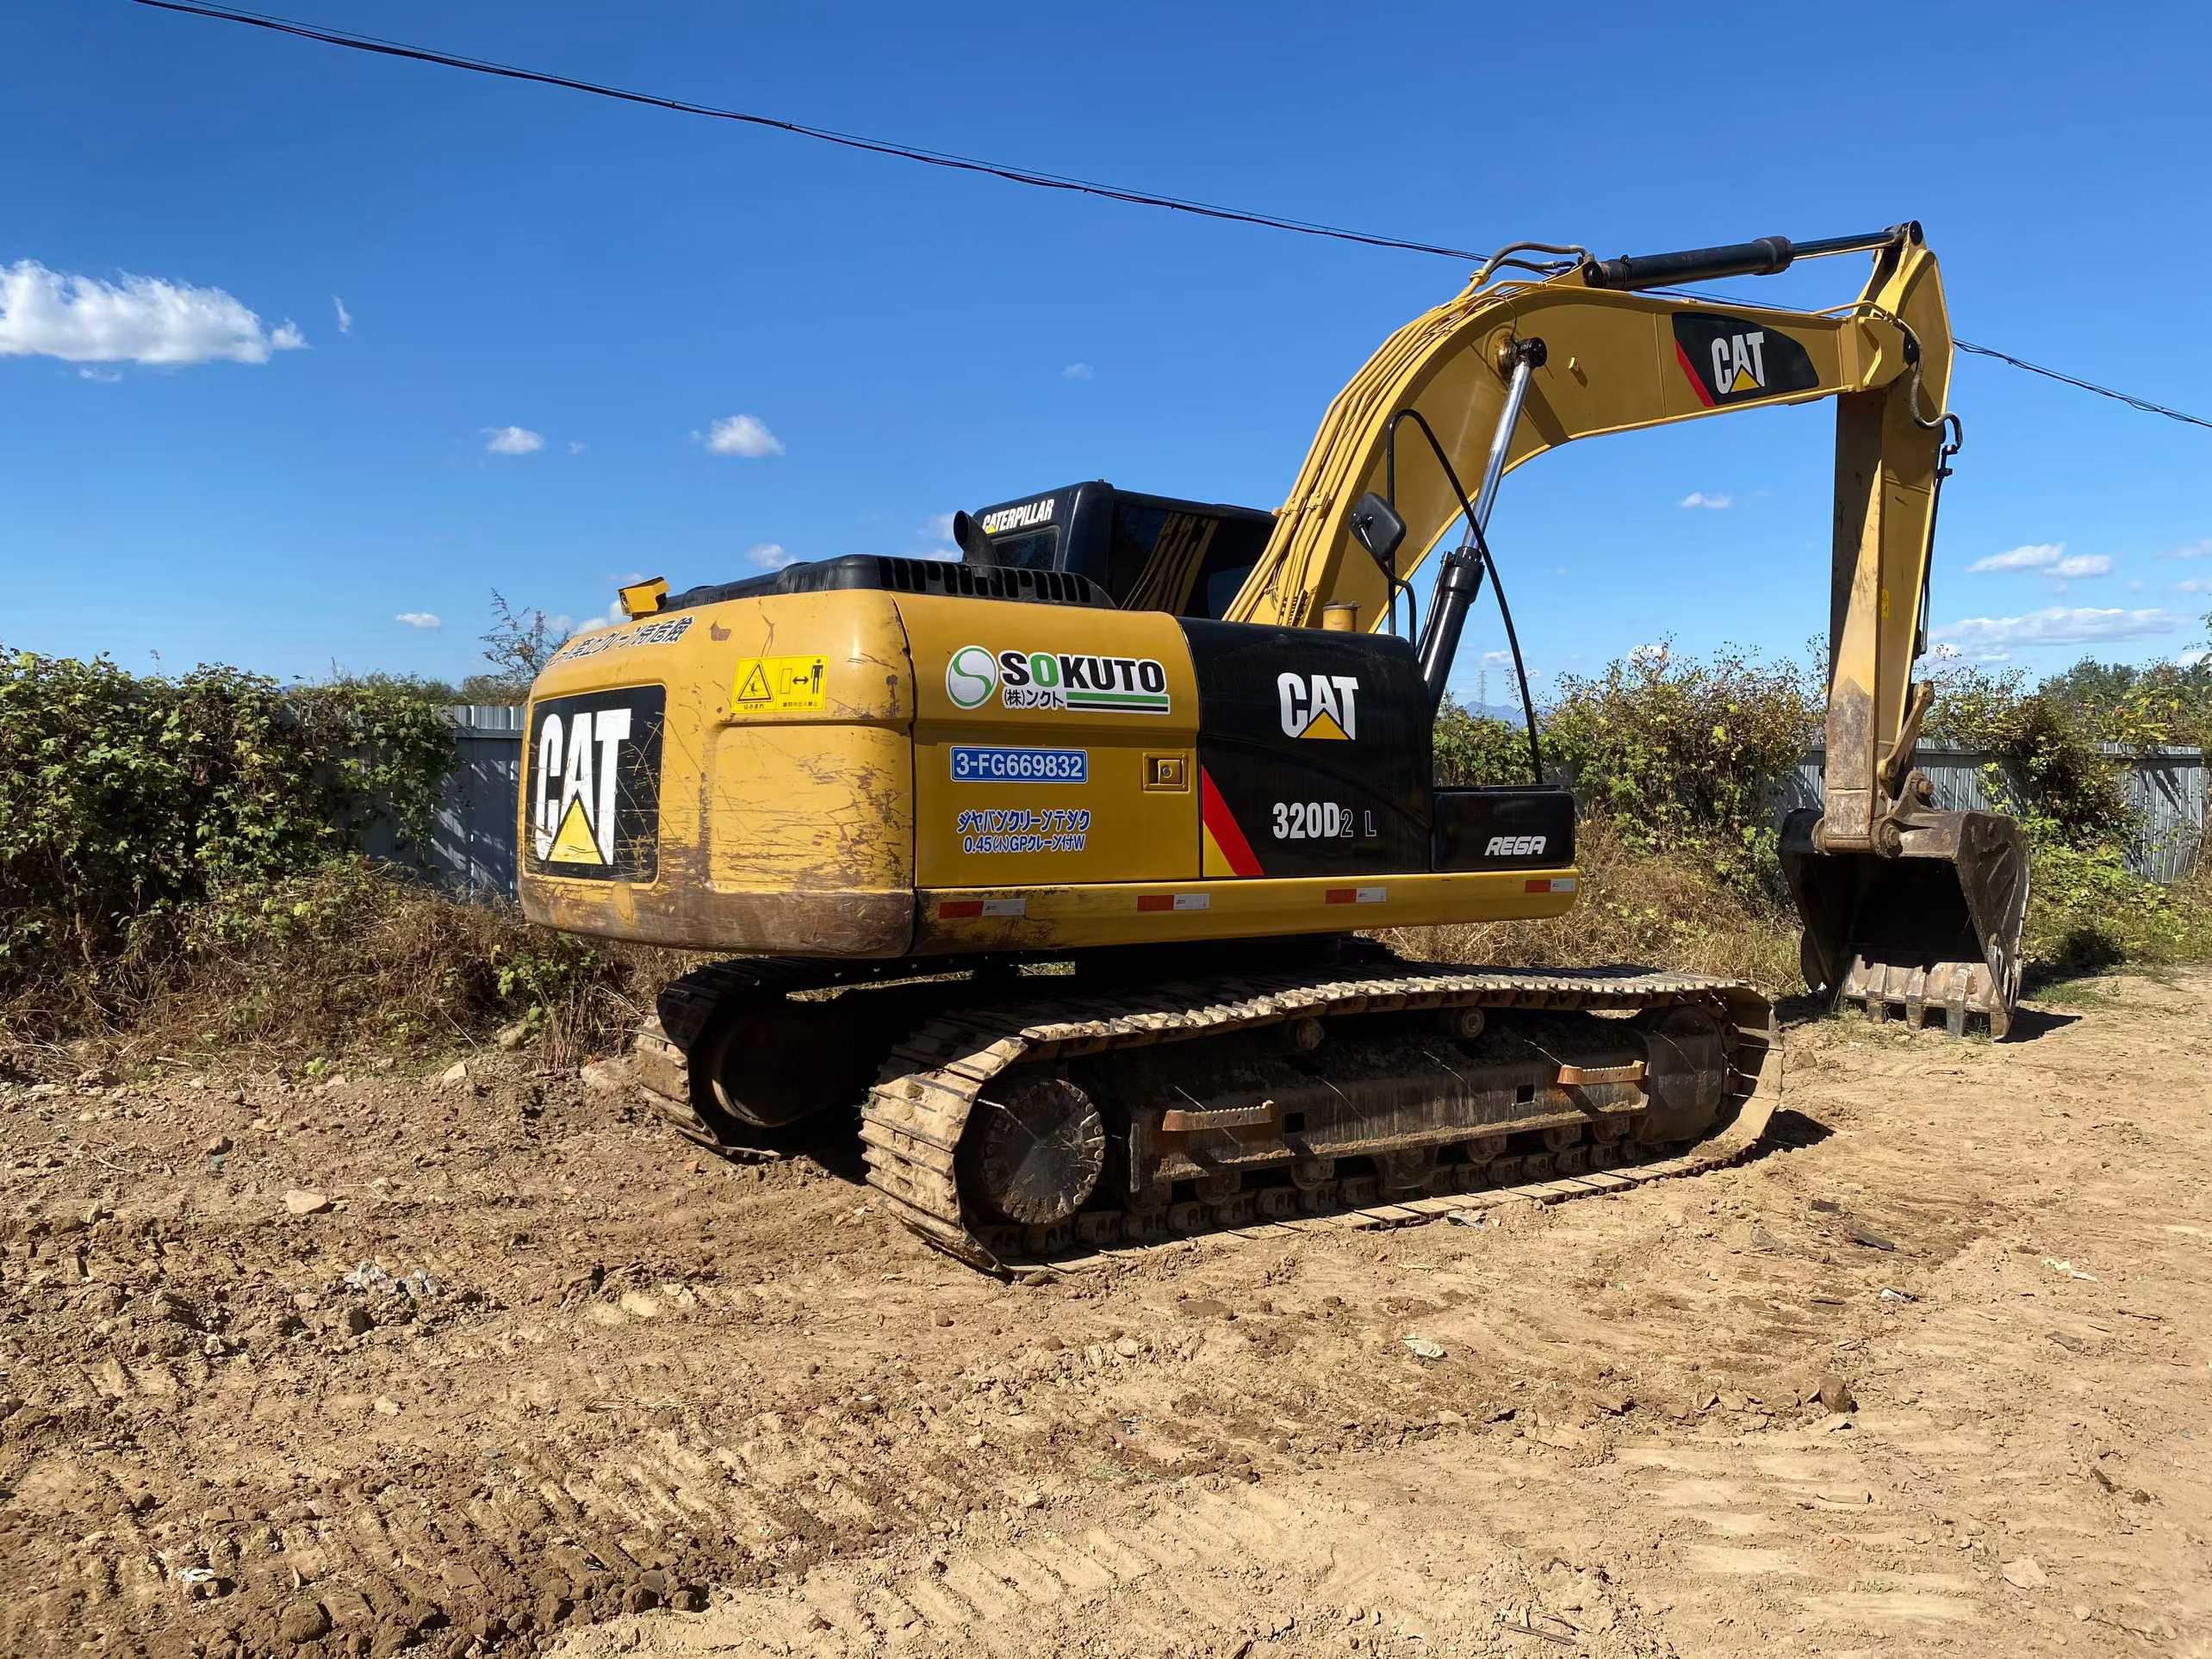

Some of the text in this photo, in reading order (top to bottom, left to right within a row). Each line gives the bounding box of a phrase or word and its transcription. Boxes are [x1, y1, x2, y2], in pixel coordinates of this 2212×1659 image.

[1711, 331, 1766, 394] CAT
[982, 498, 1055, 534] CATERPILLAR
[999, 652, 1166, 693] SOKUTO
[1277, 672, 1359, 741] CAT
[955, 752, 1084, 778] 3-FG669832
[535, 708, 631, 866] CAT
[1484, 836, 1547, 857] REGA
